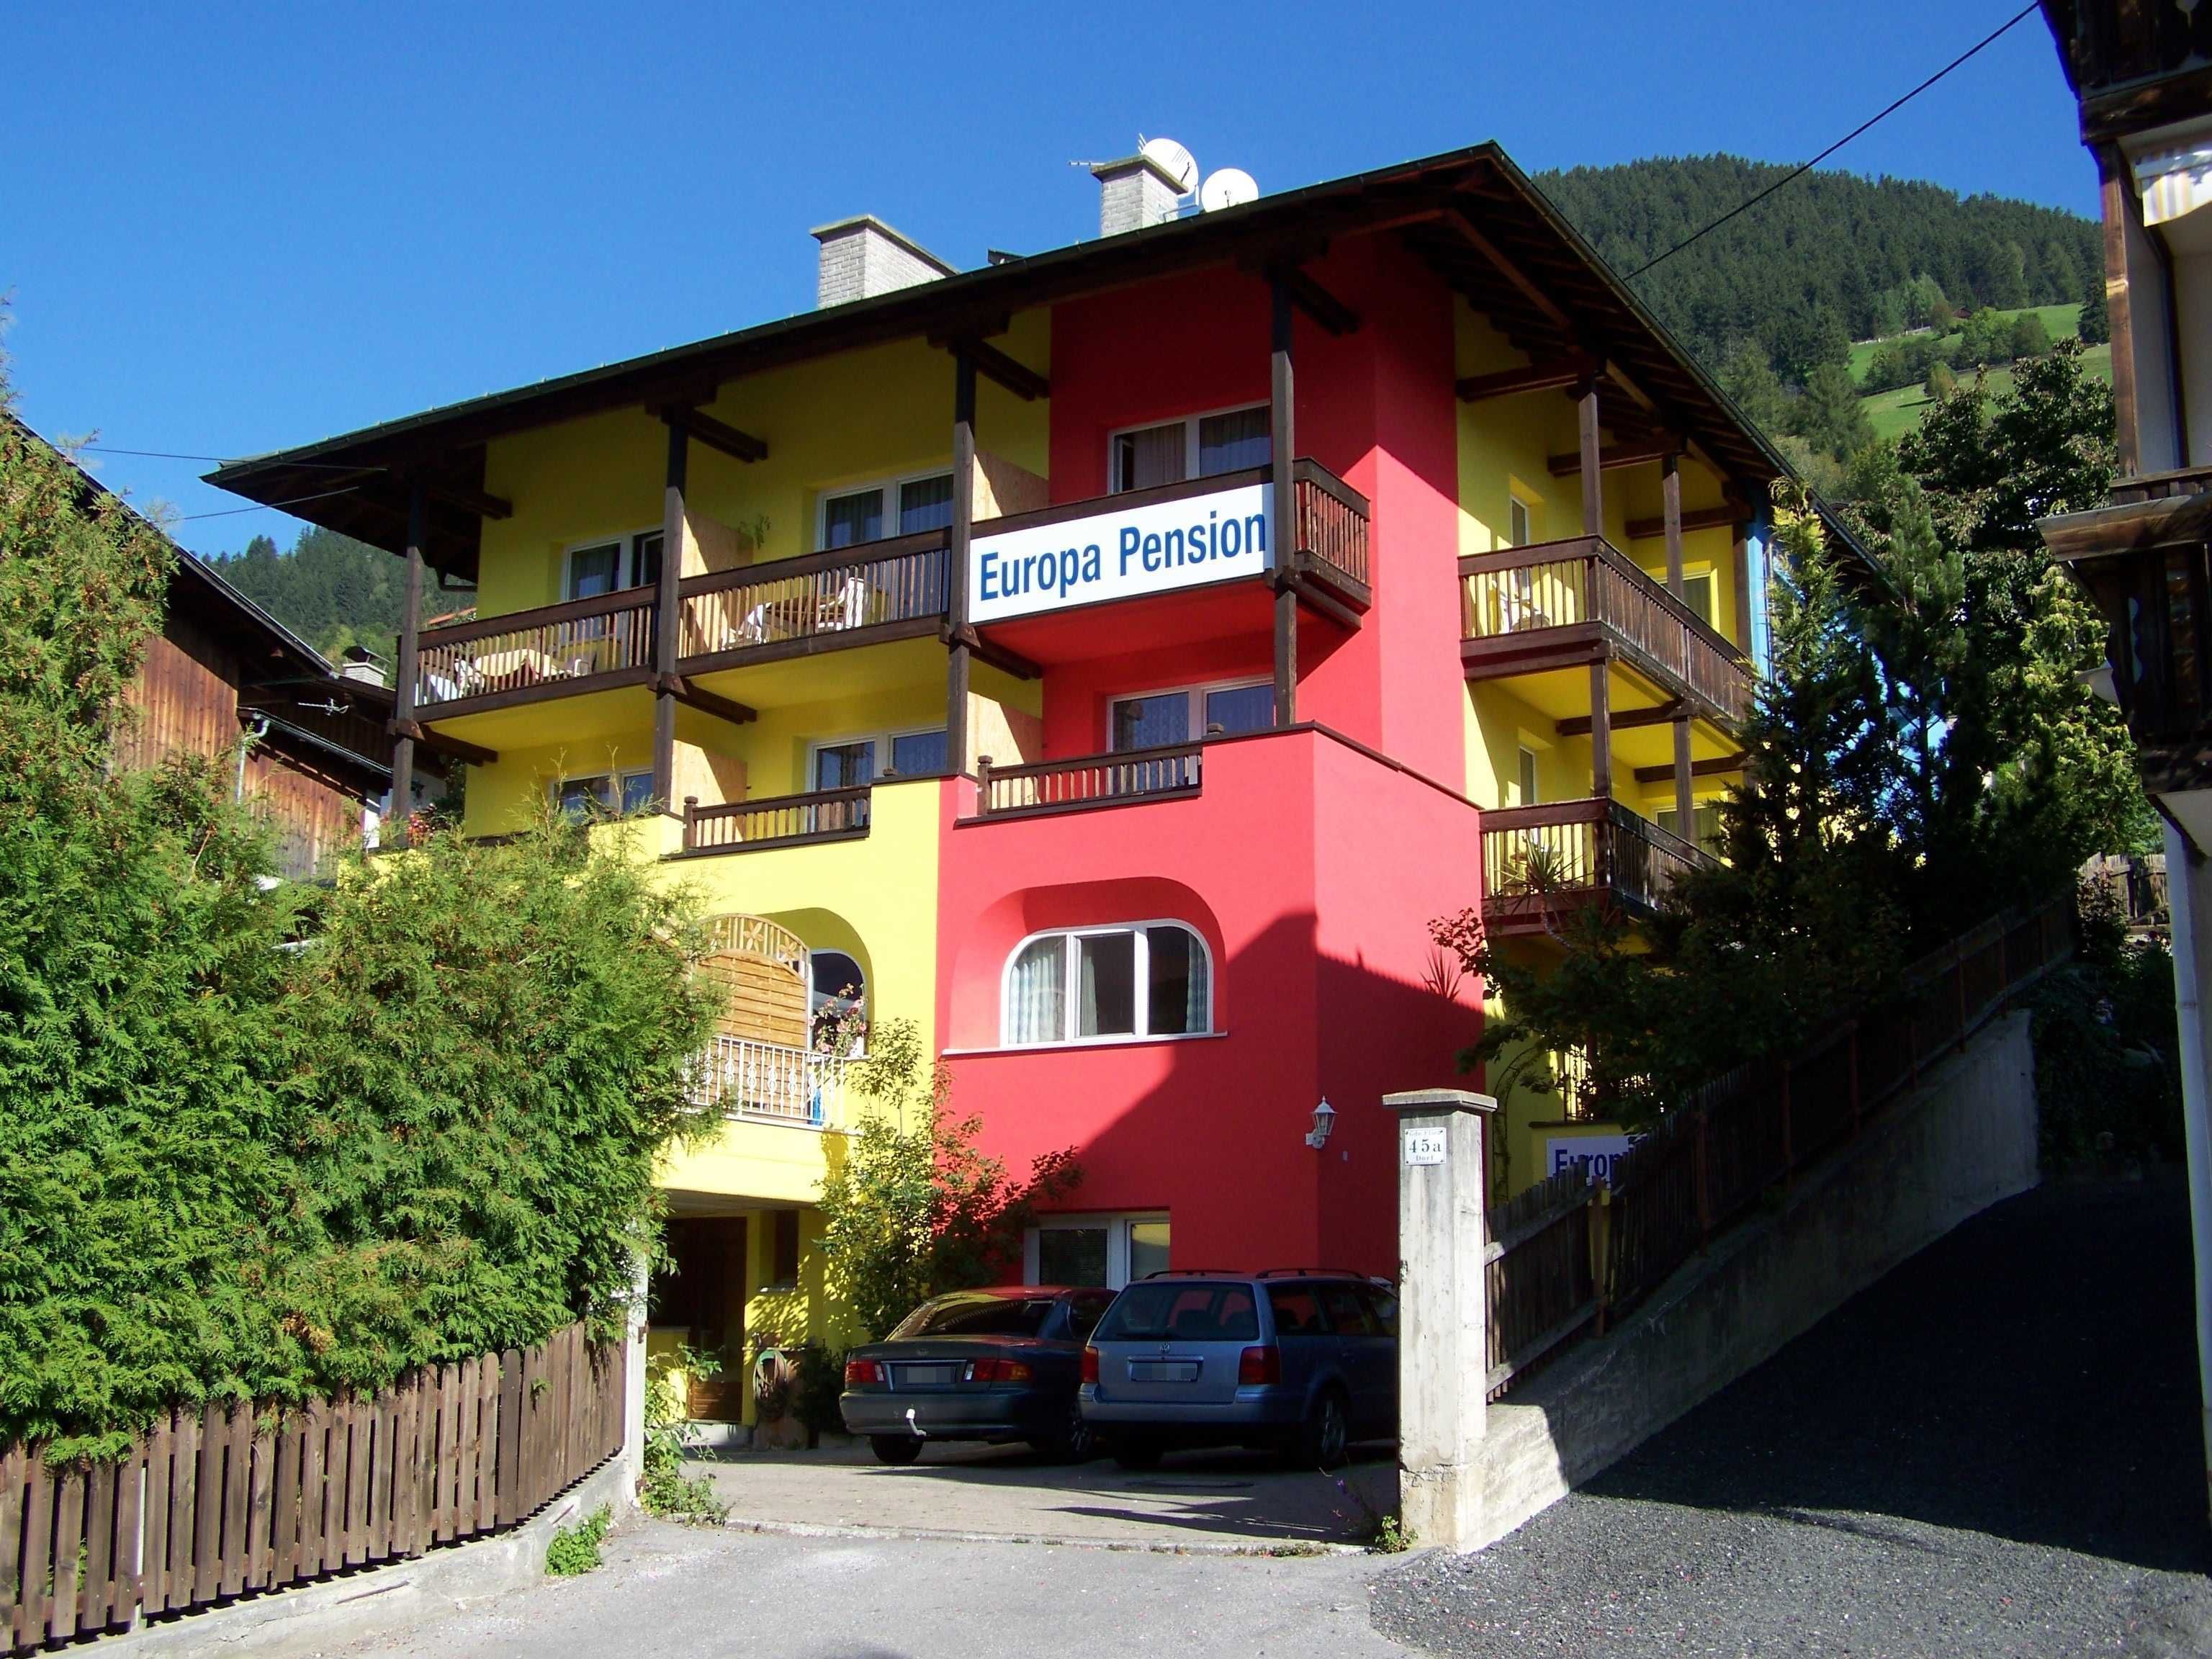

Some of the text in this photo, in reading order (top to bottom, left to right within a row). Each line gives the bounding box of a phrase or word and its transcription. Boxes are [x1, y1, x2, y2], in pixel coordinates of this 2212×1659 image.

[979, 510, 1267, 601] Europa Pension
[1408, 1138, 1442, 1153] 45a
